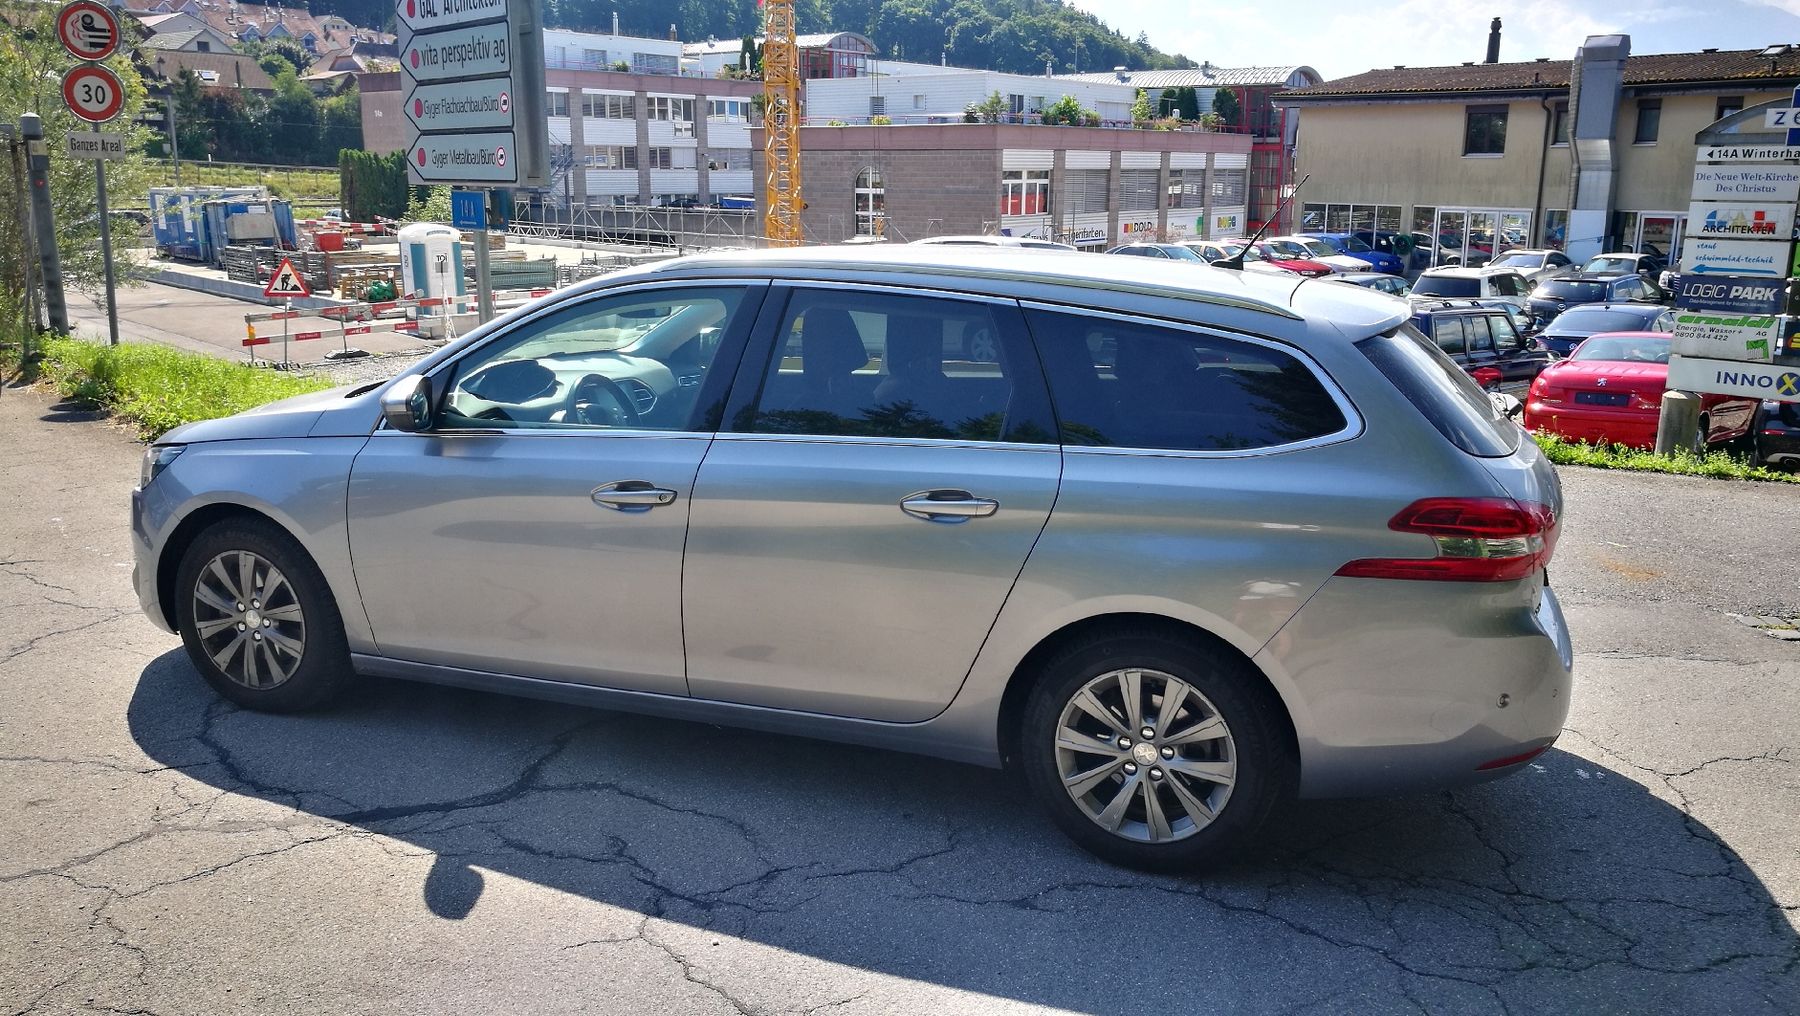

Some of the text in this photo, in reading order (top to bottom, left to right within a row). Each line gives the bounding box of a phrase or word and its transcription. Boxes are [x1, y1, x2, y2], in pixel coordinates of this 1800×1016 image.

[421, 35, 506, 70] vita perspektiv ag
[82, 84, 106, 104] 30
[70, 137, 122, 152] Ganzes Areal
[1717, 149, 1738, 158] 14A
[1695, 172, 1799, 182] Die Neue Welt-Kirche
[1715, 183, 1777, 193] Des Christus
[1701, 224, 1777, 235] ARCHITEKTEN
[1682, 283, 1779, 301] LOGIC PARK
